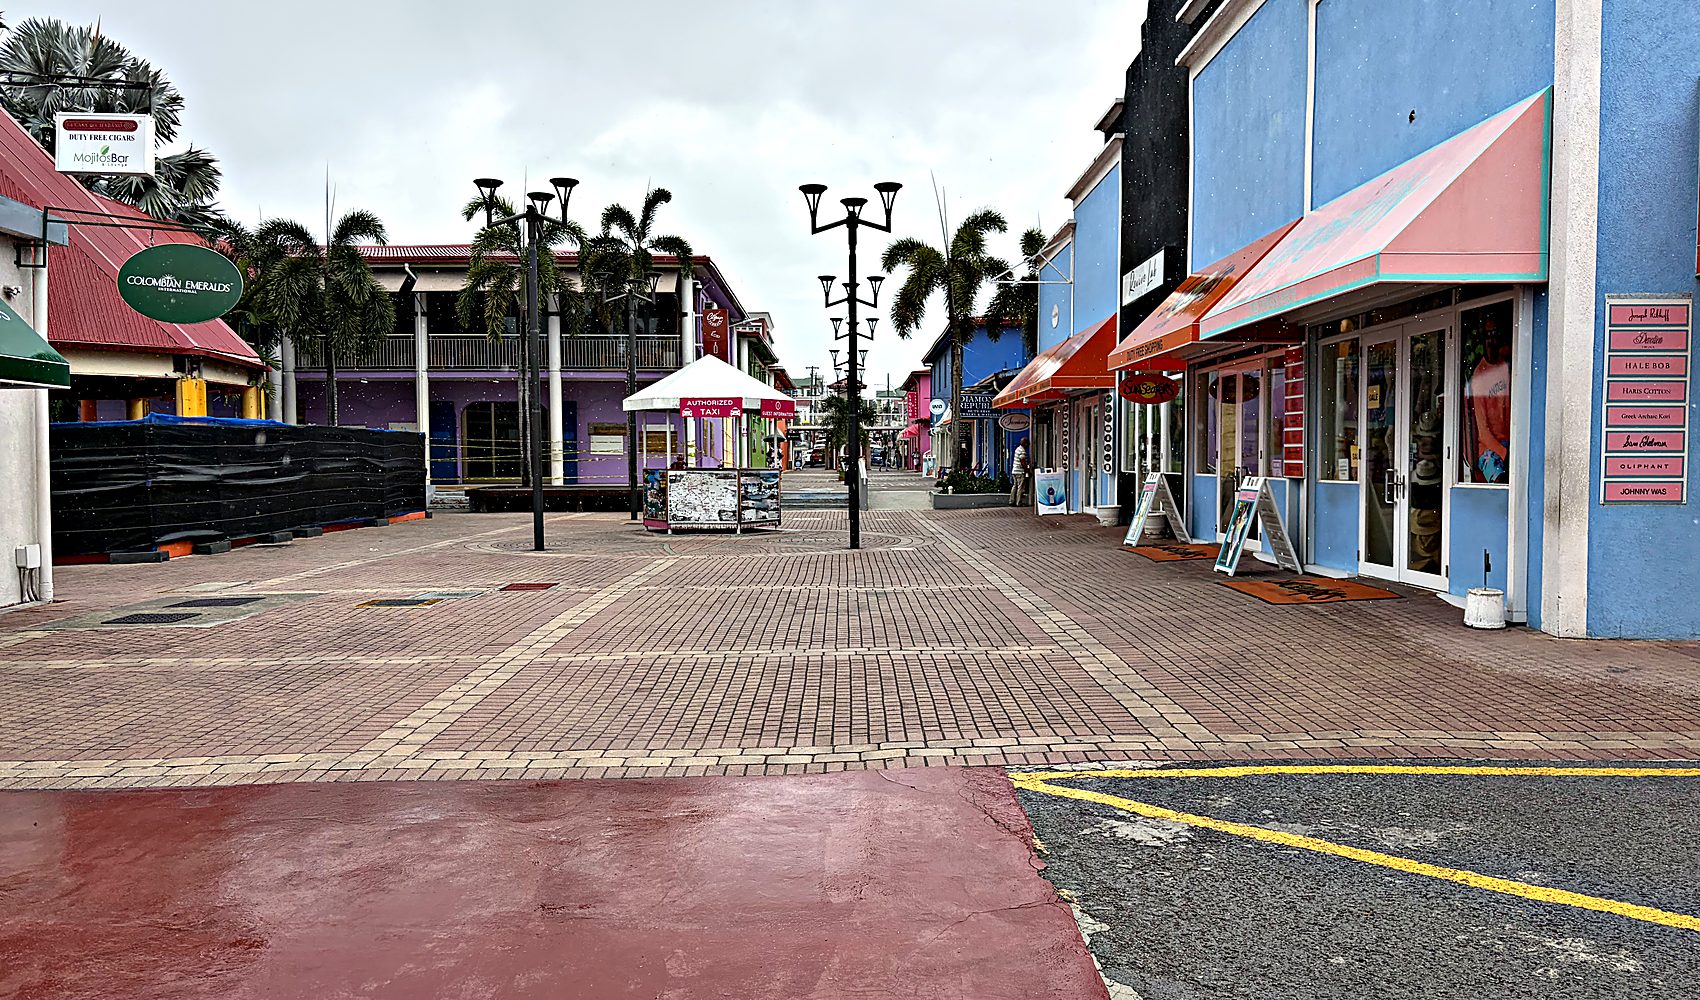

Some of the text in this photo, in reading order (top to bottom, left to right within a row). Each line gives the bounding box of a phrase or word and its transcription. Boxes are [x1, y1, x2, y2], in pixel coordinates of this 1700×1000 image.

[69, 133, 87, 141] DUTY
[126, 274, 230, 293] COLOMBIAN EMERALDS
[1136, 346, 1144, 358] FREE
[1144, 339, 1163, 354] SHOPPING
